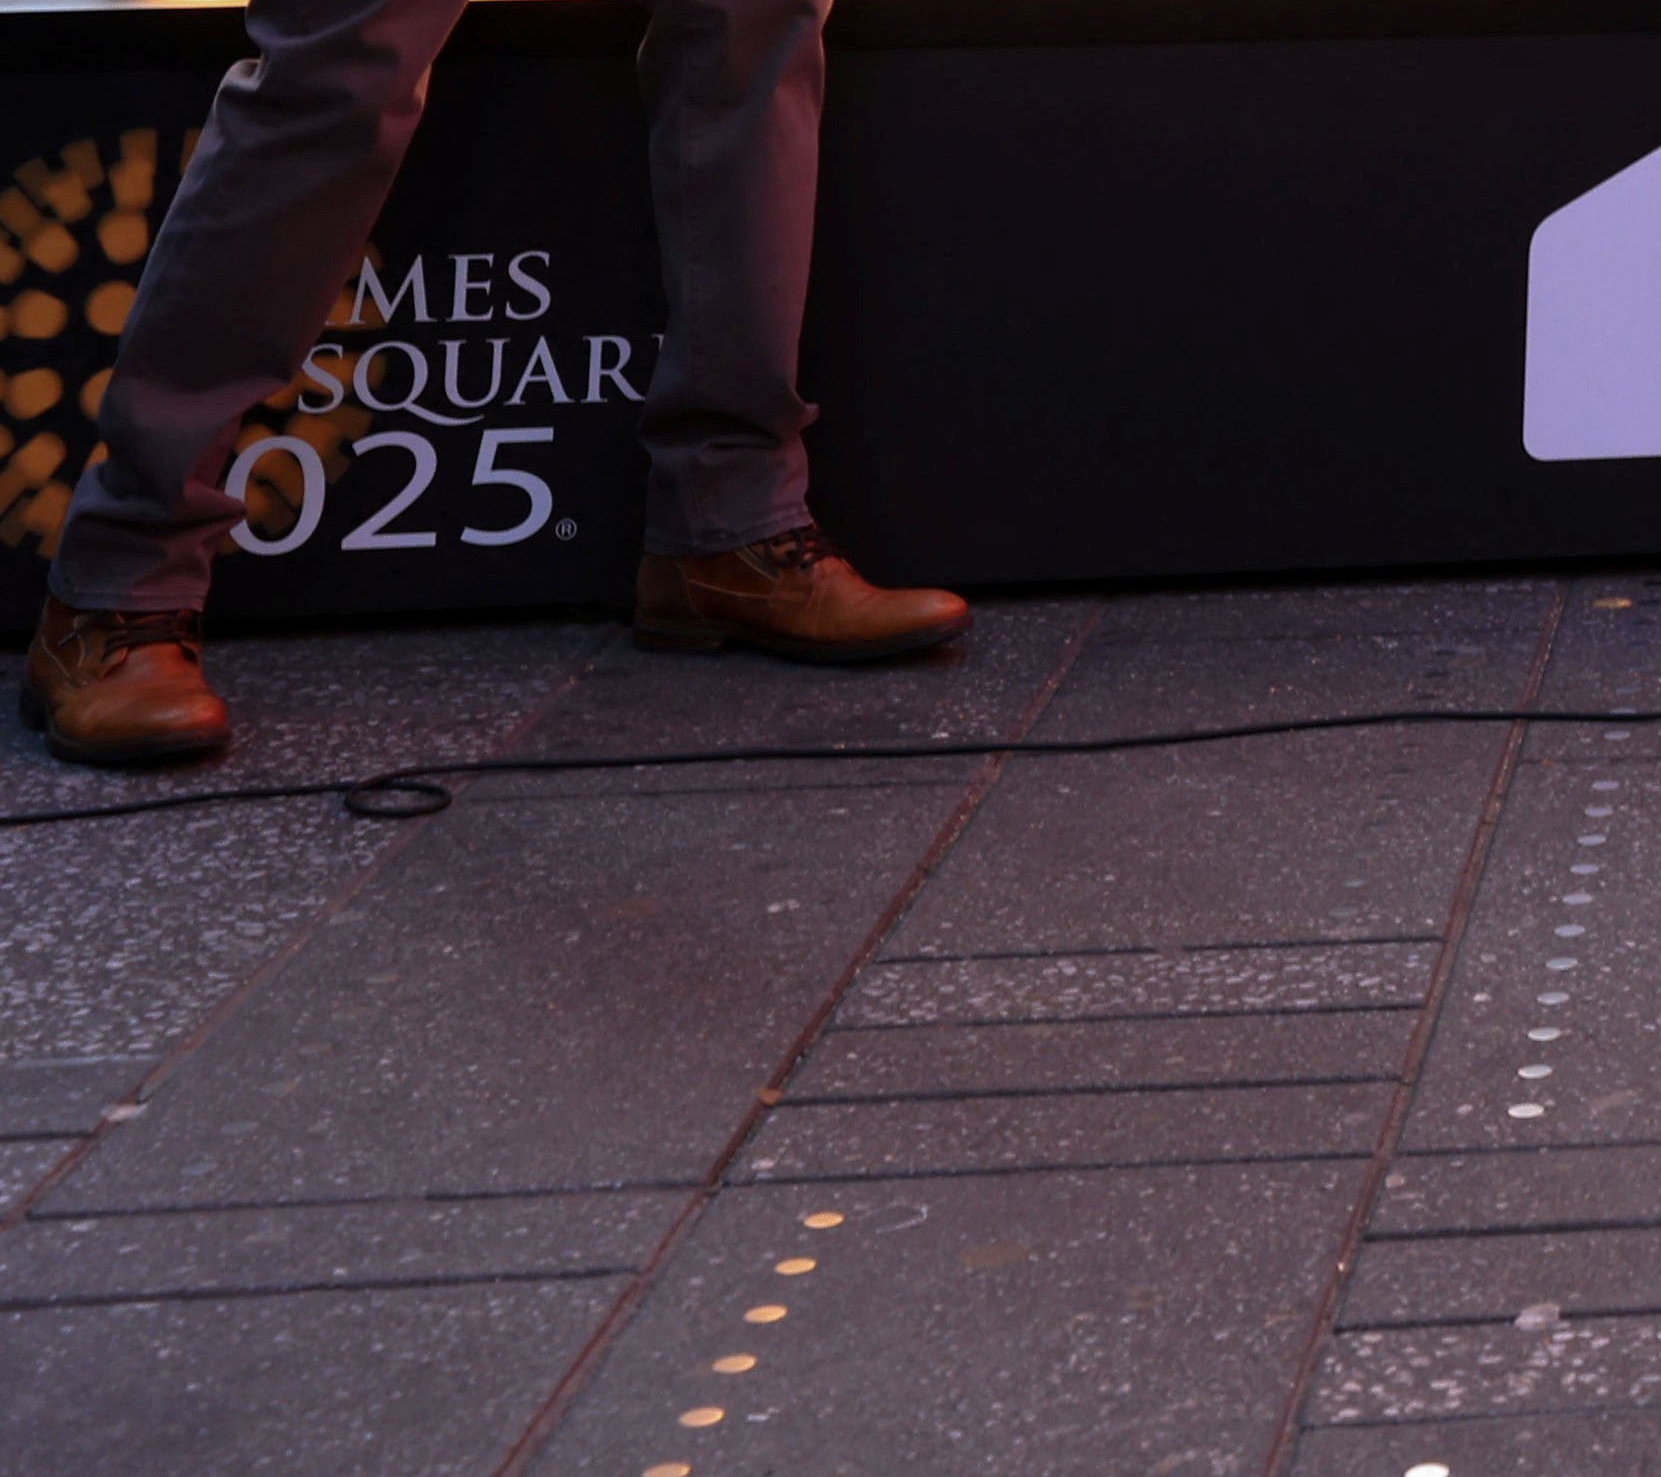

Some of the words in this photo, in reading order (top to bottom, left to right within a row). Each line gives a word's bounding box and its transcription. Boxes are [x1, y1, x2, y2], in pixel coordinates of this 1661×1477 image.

[324, 250, 553, 328] MES
[297, 332, 666, 427] SQUAR
[223, 426, 556, 557] 025
